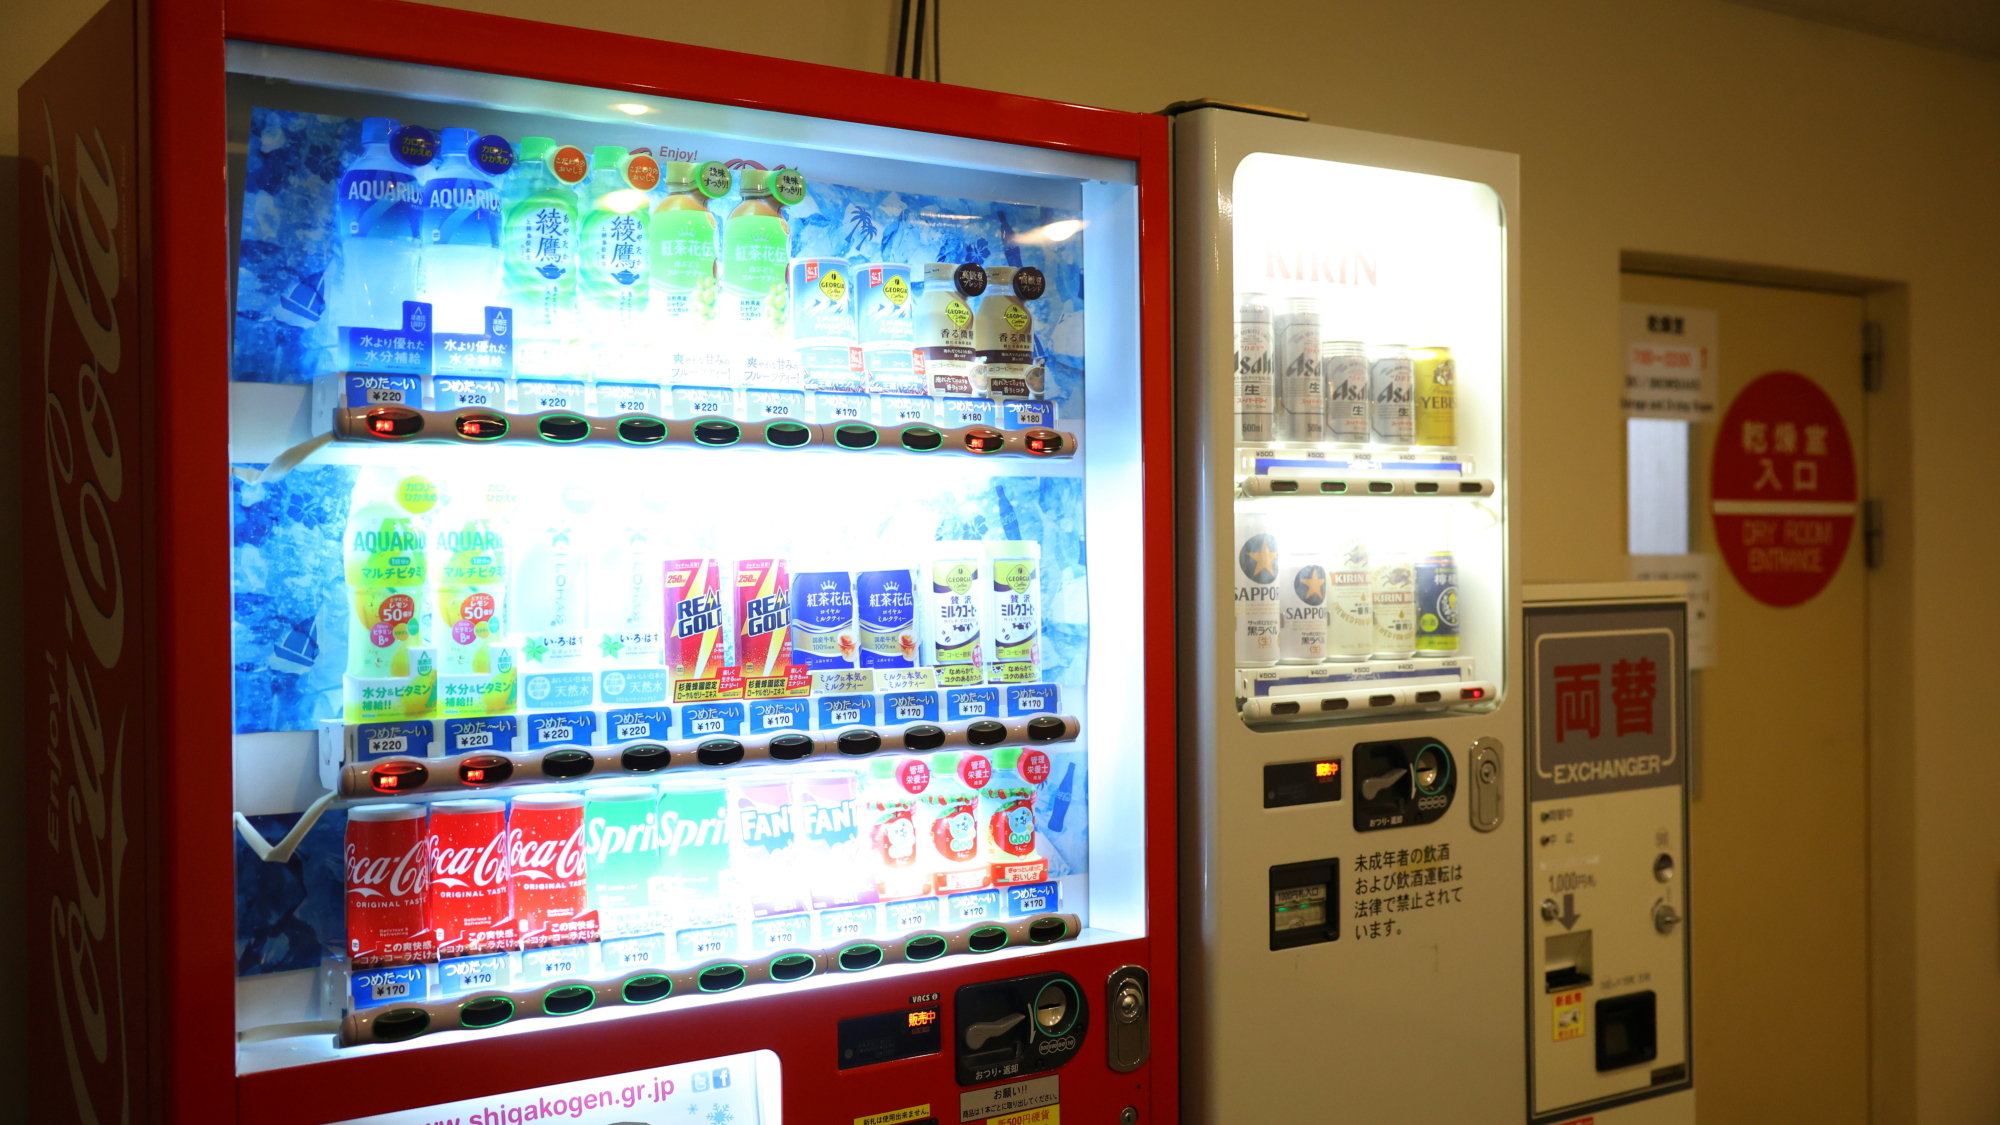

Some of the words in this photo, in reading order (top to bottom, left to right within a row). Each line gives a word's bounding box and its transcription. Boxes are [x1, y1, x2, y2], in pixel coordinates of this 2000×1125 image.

[403, 137, 432, 147] カロリー
[402, 146, 433, 158] ひかえめ
[659, 146, 698, 162] Enjoy!
[481, 154, 510, 165] ひかえめ
[708, 167, 726, 178] 後味
[782, 175, 799, 186] 後味
[348, 180, 423, 206] AQUARIUS
[429, 188, 502, 213] AQUARIUS
[535, 207, 563, 263] 綾鷹
[610, 214, 637, 269] 綾鷹
[661, 239, 714, 257] 紅茶花伝
[735, 245, 787, 263] 紅茶花伝
[1265, 245, 1377, 286] KIRIN
[821, 281, 845, 289] GEORGIA
[365, 350, 421, 365] 水分補給
[449, 353, 503, 367] 水分補給
[1245, 384, 1260, 396] 生
[1309, 382, 1321, 394] 生
[372, 391, 402, 402] ¥220
[459, 395, 487, 404] ¥220
[541, 398, 567, 407] ¥220
[619, 401, 645, 411] ¥220
[765, 406, 789, 415] ¥220
[835, 408, 857, 417] ¥170
[1352, 405, 1364, 416] 生
[1398, 406, 1409, 417] 生
[962, 413, 982, 421] ¥180
[1020, 415, 1040, 423] ¥180
[1753, 458, 1819, 491] 入口
[1742, 519, 1777, 545] DRY
[1784, 521, 1833, 545] ROOM
[1748, 547, 1823, 574] ENTRANCE
[1334, 574, 1364, 584] KIRIN
[807, 591, 852, 607] 紅茶花伝
[869, 592, 913, 607] 紅茶花伝
[1373, 595, 1402, 603] KIRIN
[815, 615, 846, 623] ミルクティー
[1247, 625, 1277, 636] 黒ラベル
[1301, 636, 1325, 645] 黒ラベル
[819, 672, 867, 683] ミルクに本気の
[883, 671, 928, 681] ミルクに本気の
[445, 682, 512, 696] 水分&ビタミン
[629, 681, 663, 694] 天然水
[824, 680, 864, 691] ミルクティー
[889, 680, 926, 689] ミルクティー
[362, 684, 431, 699] 水分&ビタミン
[555, 684, 590, 698] 天然水
[677, 690, 717, 700] ローヤルゼリーエキス
[362, 699, 391, 711] 補給!!
[445, 697, 473, 707] 補給!!
[1021, 699, 1042, 708] ¥170
[1553, 657, 1657, 744] 両替
[900, 708, 921, 717] ¥170
[962, 705, 983, 713] ¥170
[767, 716, 790, 725] ¥170
[835, 711, 857, 720] ¥170
[621, 726, 646, 737] ¥220
[697, 722, 721, 730] ¥170
[543, 729, 569, 739] ¥220
[373, 741, 402, 751] ¥220
[461, 736, 488, 746] ¥220
[971, 759, 985, 769] 管理
[1030, 755, 1045, 764] 管理
[909, 765, 924, 774] 管理
[968, 769, 989, 779] 栄養士
[1027, 764, 1048, 774] 栄養士
[1554, 755, 1661, 784] EXCHANGER
[906, 774, 928, 784] 栄養士
[1009, 832, 1031, 844] Qoo
[1354, 843, 1450, 873] 未成年者の飲酒
[1012, 873, 1038, 882] おいしさ
[1355, 864, 1463, 895] および飲酒運転は
[523, 882, 567, 891] ORIGINAL
[440, 890, 485, 899] ORIGINAL
[356, 901, 401, 909] ORIGINAL
[1023, 899, 1044, 908] ¥170
[1354, 887, 1463, 918] 法律で禁止されて
[963, 907, 984, 916] ¥170
[901, 915, 922, 925] ¥170
[551, 920, 599, 932] この爽快感。
[1355, 918, 1402, 940] います。
[468, 930, 518, 942] この爽快感。
[531, 931, 600, 943] コカ・コーラだけ。
[769, 933, 793, 943] ¥170
[383, 941, 435, 953] この爽快感。
[446, 941, 519, 953] コカ・コーラだけ。
[360, 953, 437, 965] コカ・コーラだけ。
[623, 952, 649, 963] ¥170
[545, 962, 572, 972] ¥170
[464, 974, 492, 984] ¥170
[376, 985, 406, 995] ¥170
[912, 993, 931, 1002] VACS
[908, 1010, 936, 1028] 販売中
[975, 1064, 1019, 1080] おつり・返却
[993, 1084, 1028, 1100] お願い!!
[421, 1077, 675, 1125] w.shigakogen.gr.jp
[962, 1092, 1059, 1119] 商品は1本ごとに取り出してください。
